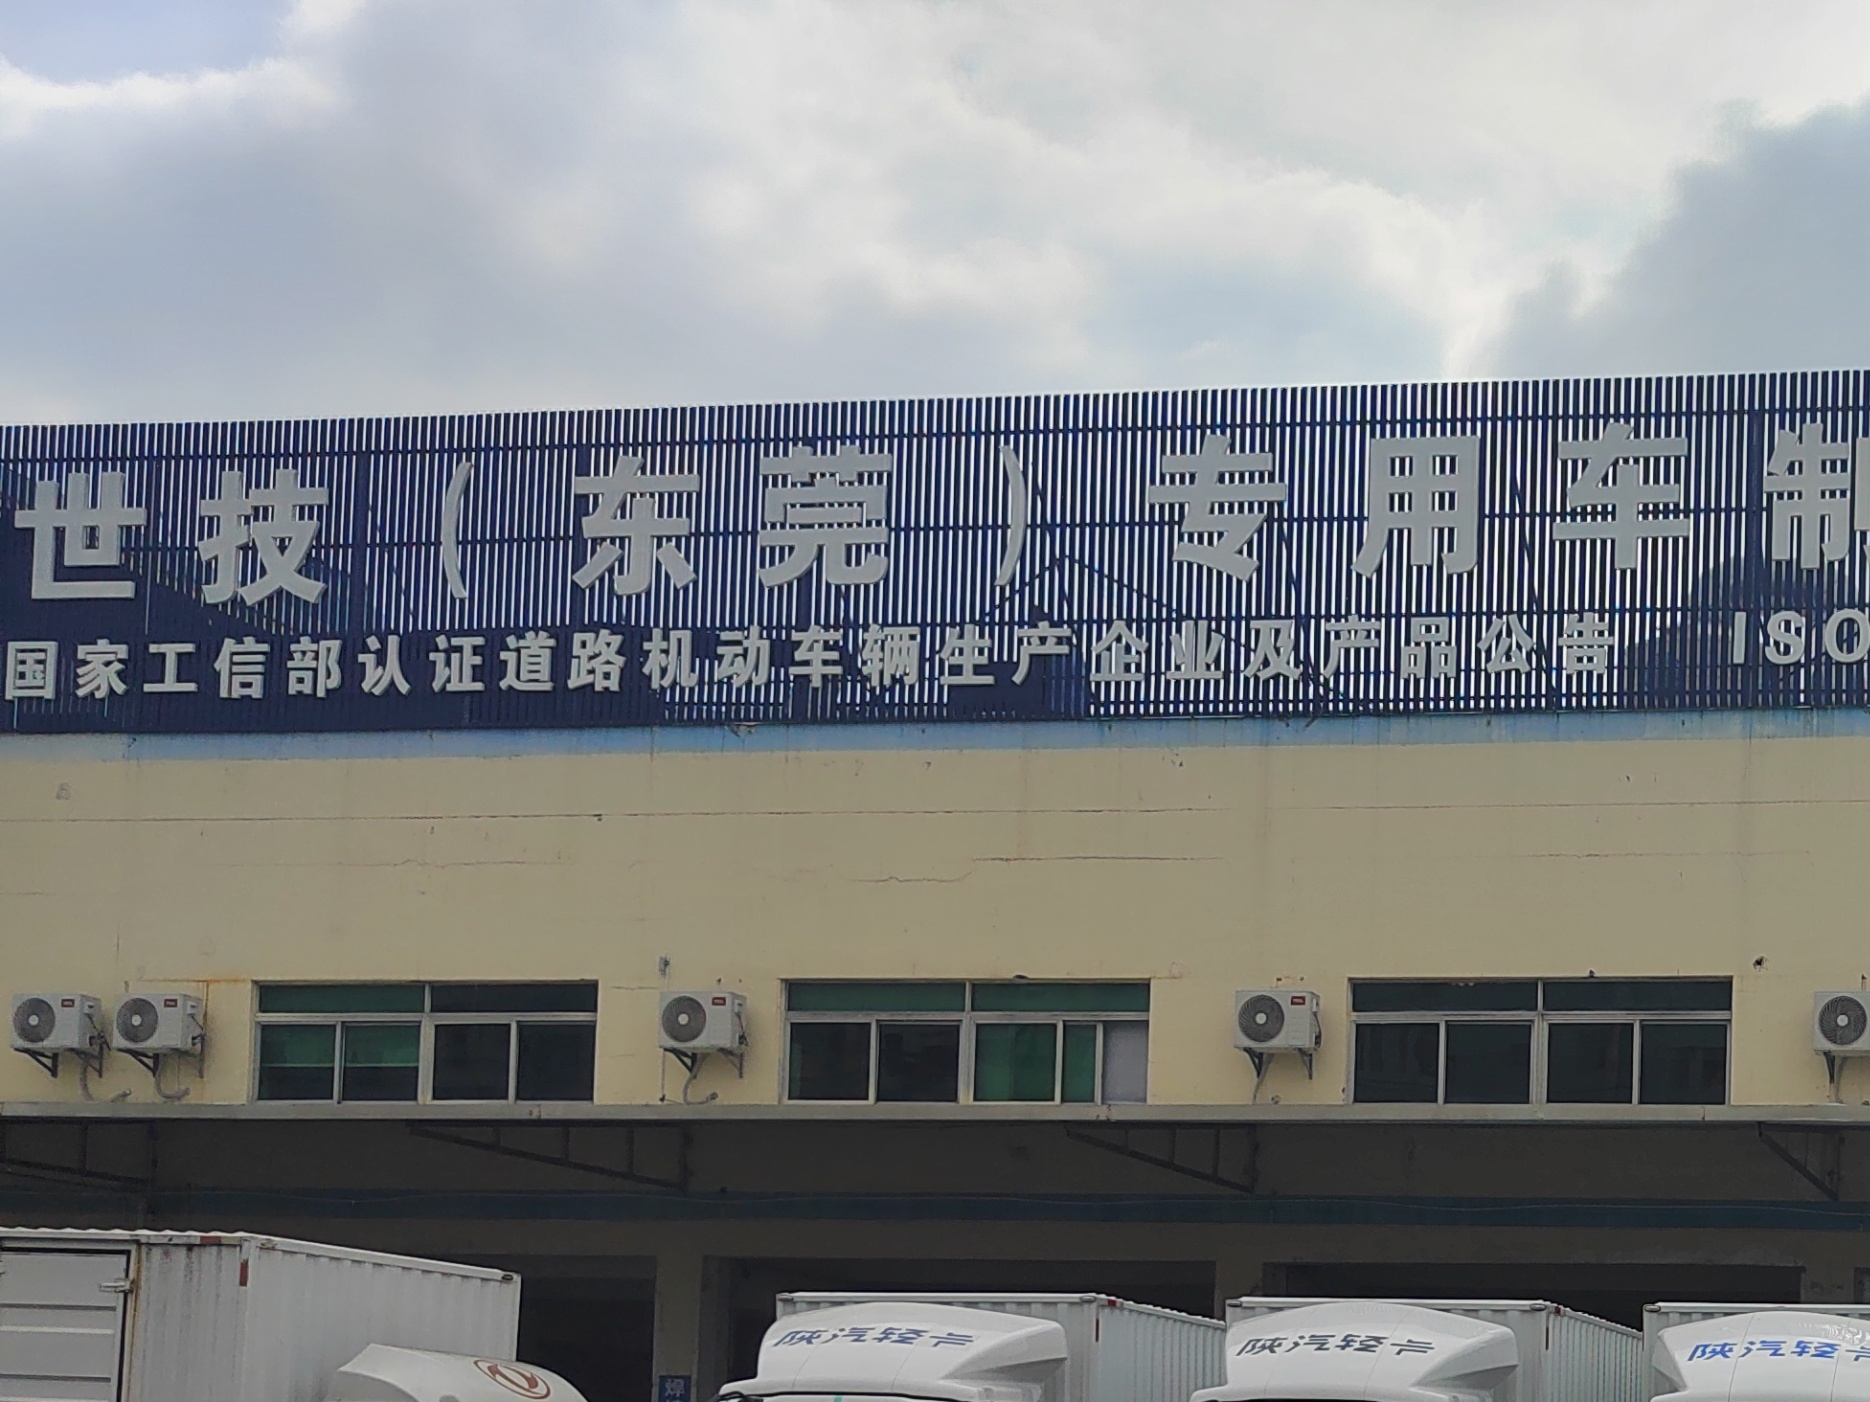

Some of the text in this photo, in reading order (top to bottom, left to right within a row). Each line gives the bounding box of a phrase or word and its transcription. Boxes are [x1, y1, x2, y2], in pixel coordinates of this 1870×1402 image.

[4, 616, 1614, 702] 国家工信部认证道路机动车辆生产企业及产品公告
[772, 1327, 974, 1347] 陕汽轻卡
[1235, 1333, 1435, 1356] 陕汽轻卡
